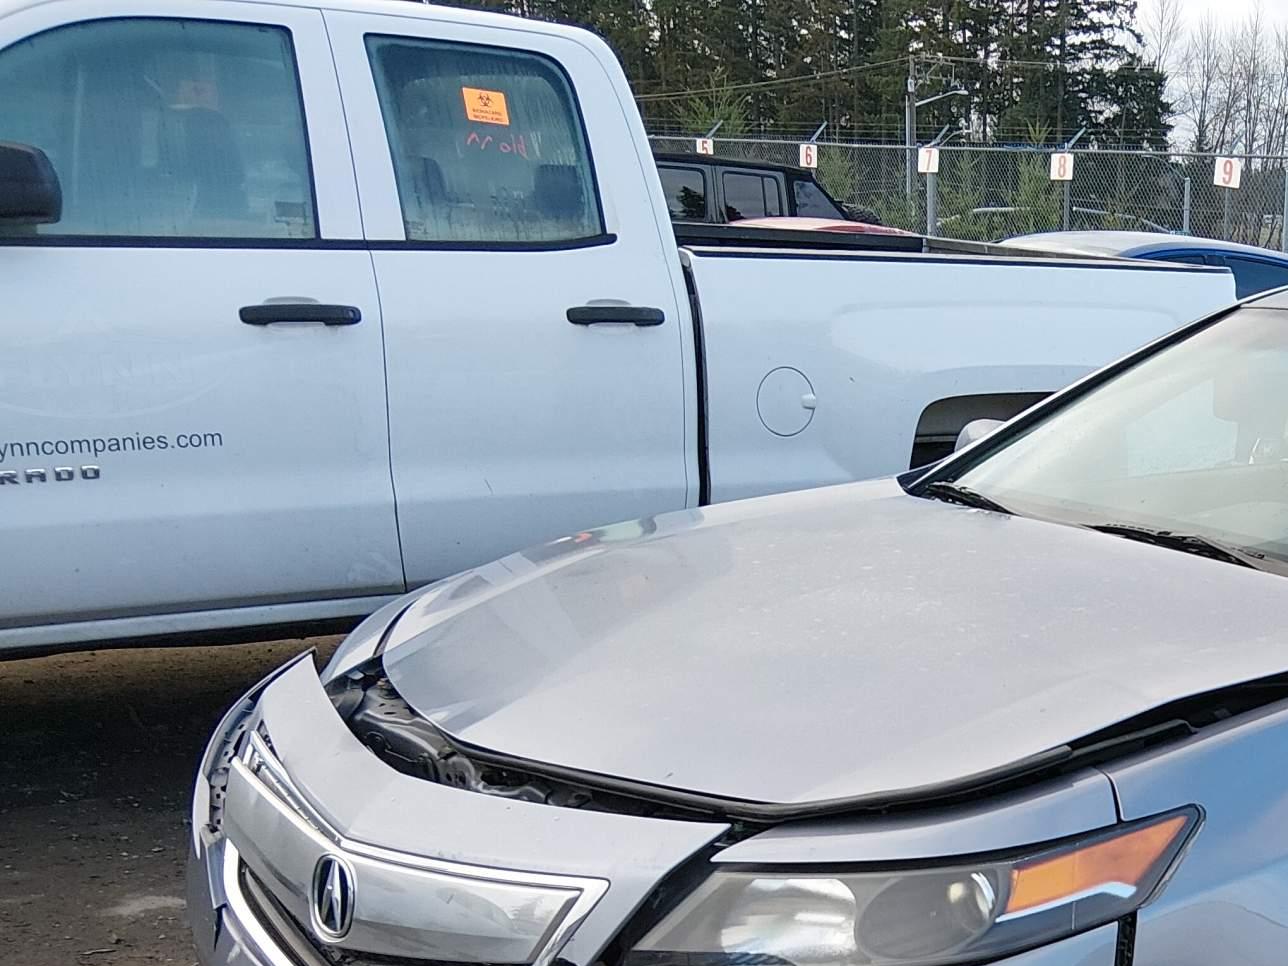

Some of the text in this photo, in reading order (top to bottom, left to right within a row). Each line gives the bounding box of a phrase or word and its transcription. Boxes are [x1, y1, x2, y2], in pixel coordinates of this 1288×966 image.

[701, 141, 709, 155] 5
[805, 146, 813, 166] 6
[925, 150, 933, 171] 7
[1057, 155, 1067, 178] 8
[1222, 159, 1233, 185] 9
